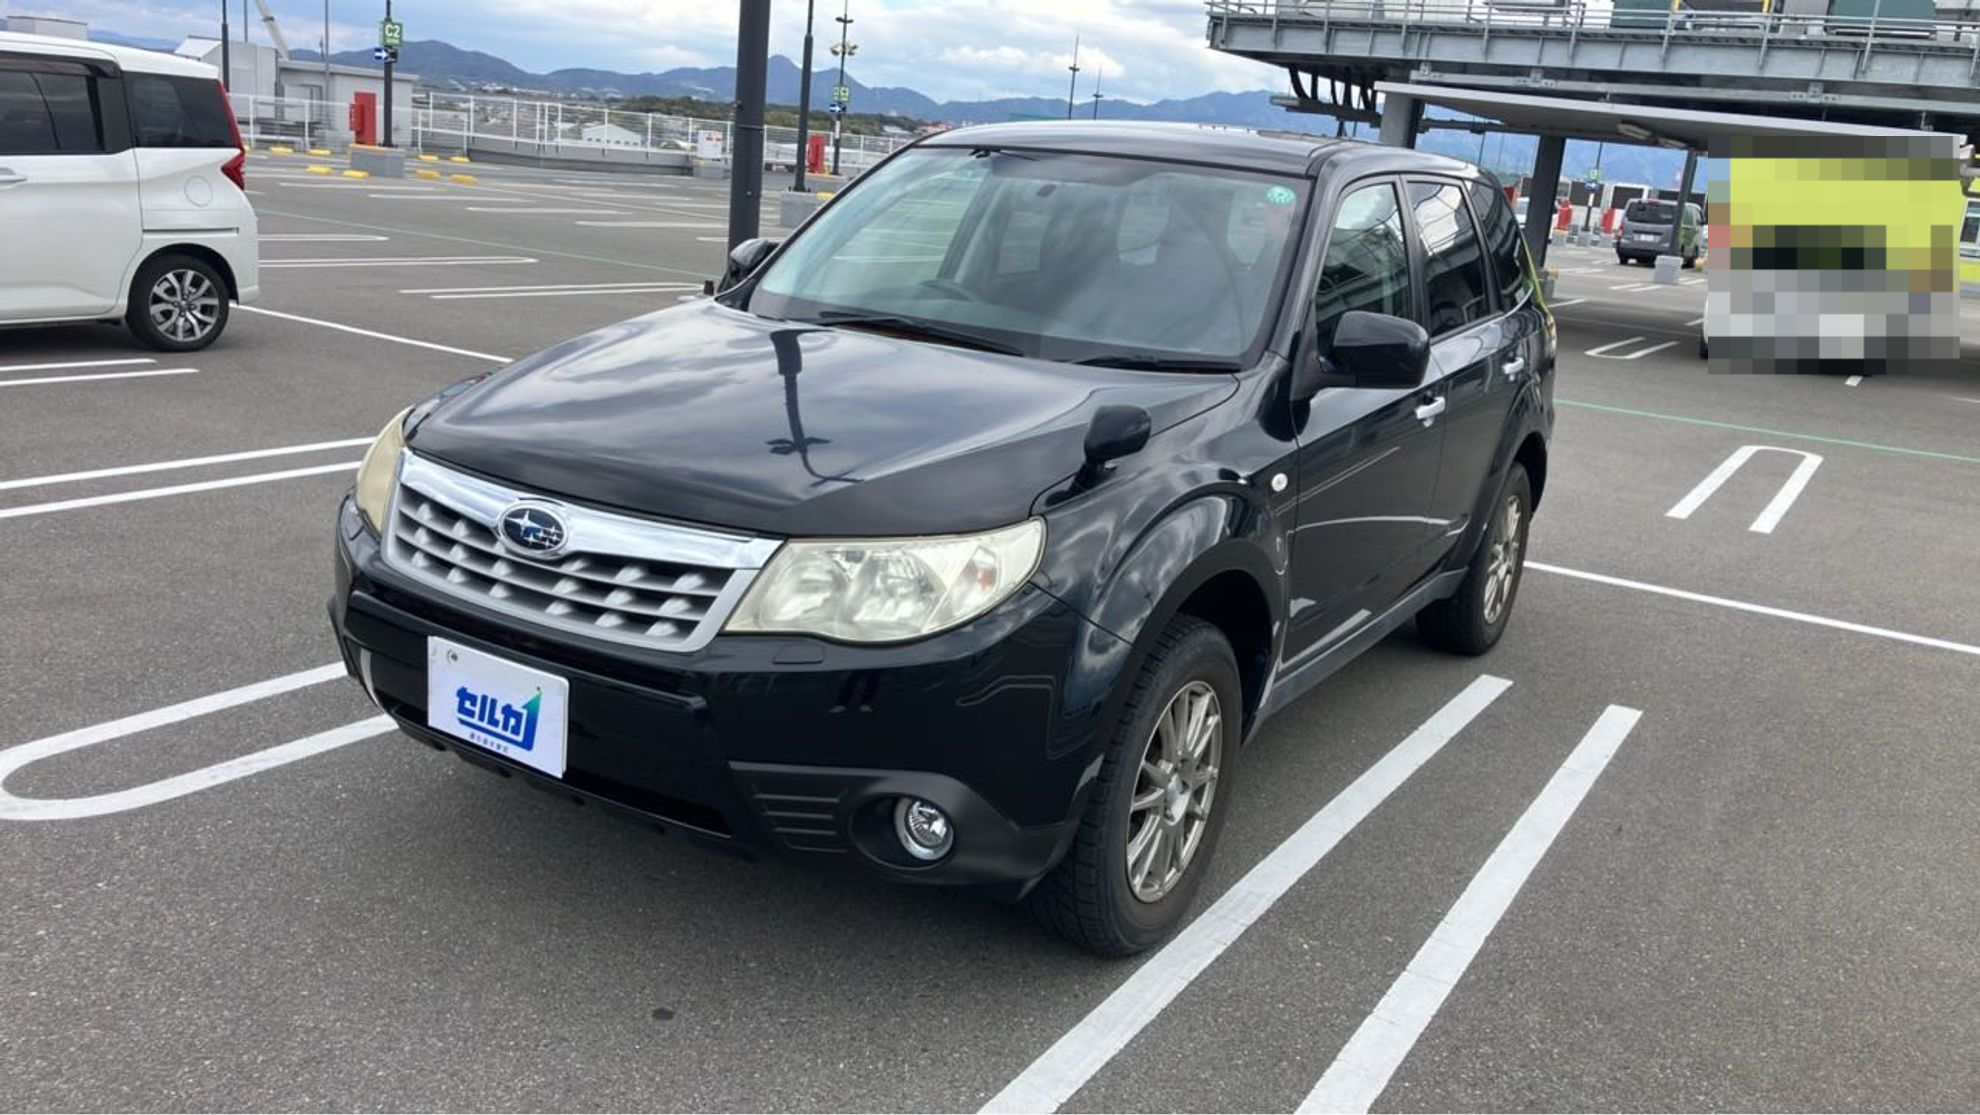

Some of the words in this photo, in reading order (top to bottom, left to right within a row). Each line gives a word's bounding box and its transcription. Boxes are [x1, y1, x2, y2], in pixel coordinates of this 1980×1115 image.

[385, 24, 400, 38] C2
[456, 686, 525, 737] セルカ
